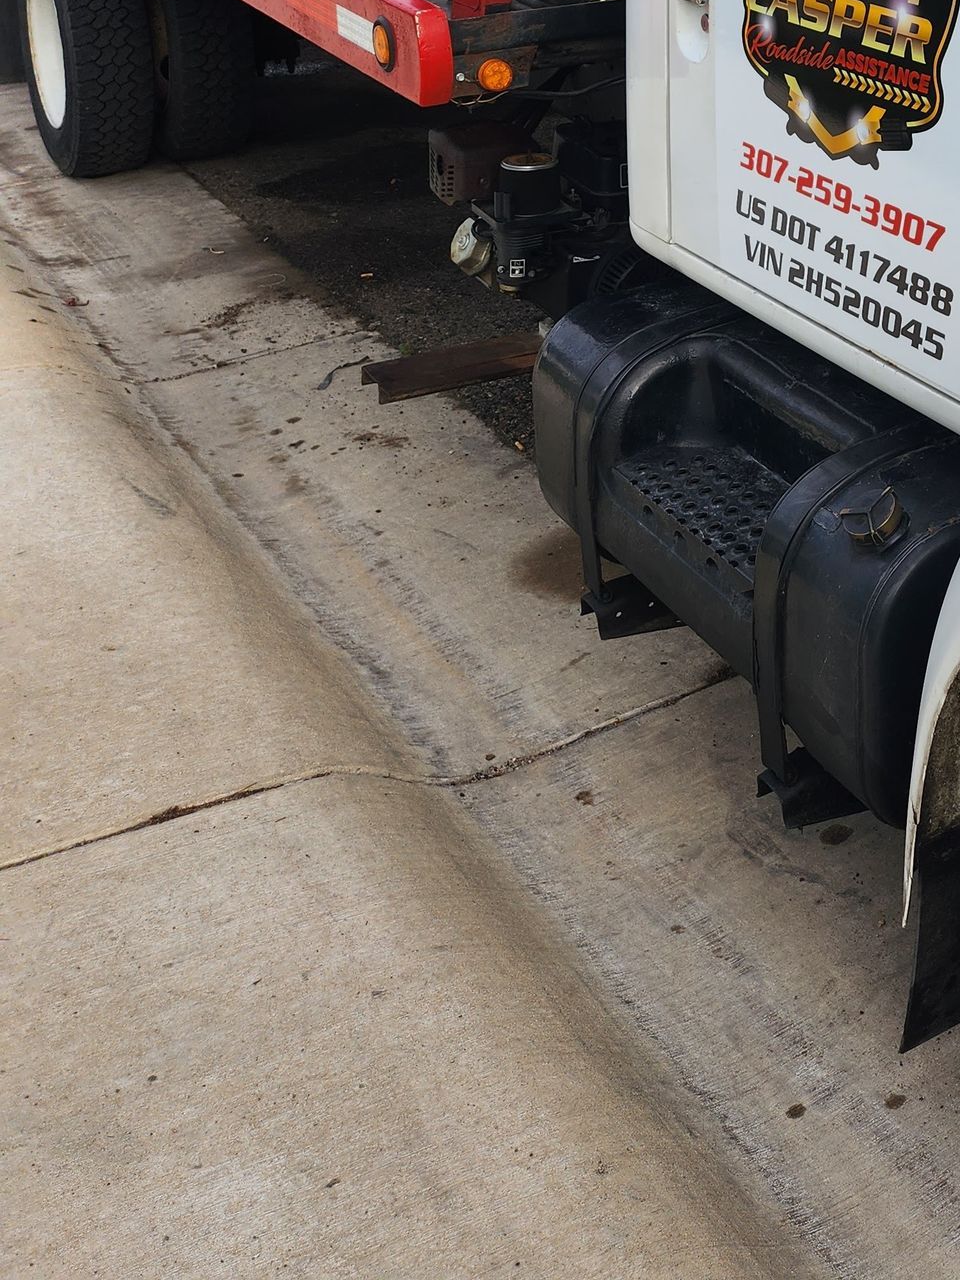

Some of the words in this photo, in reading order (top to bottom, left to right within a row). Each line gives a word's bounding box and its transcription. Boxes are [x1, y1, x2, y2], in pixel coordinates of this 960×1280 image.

[747, 23, 835, 71] Roadside
[833, 47, 932, 95] ASSISTANCE
[735, 188, 767, 226] US
[770, 205, 821, 252] DOT
[824, 235, 954, 317] 4117488
[739, 141, 946, 252] 307-259-3907
[743, 233, 784, 278] VIN
[787, 257, 946, 361] 2H520045
